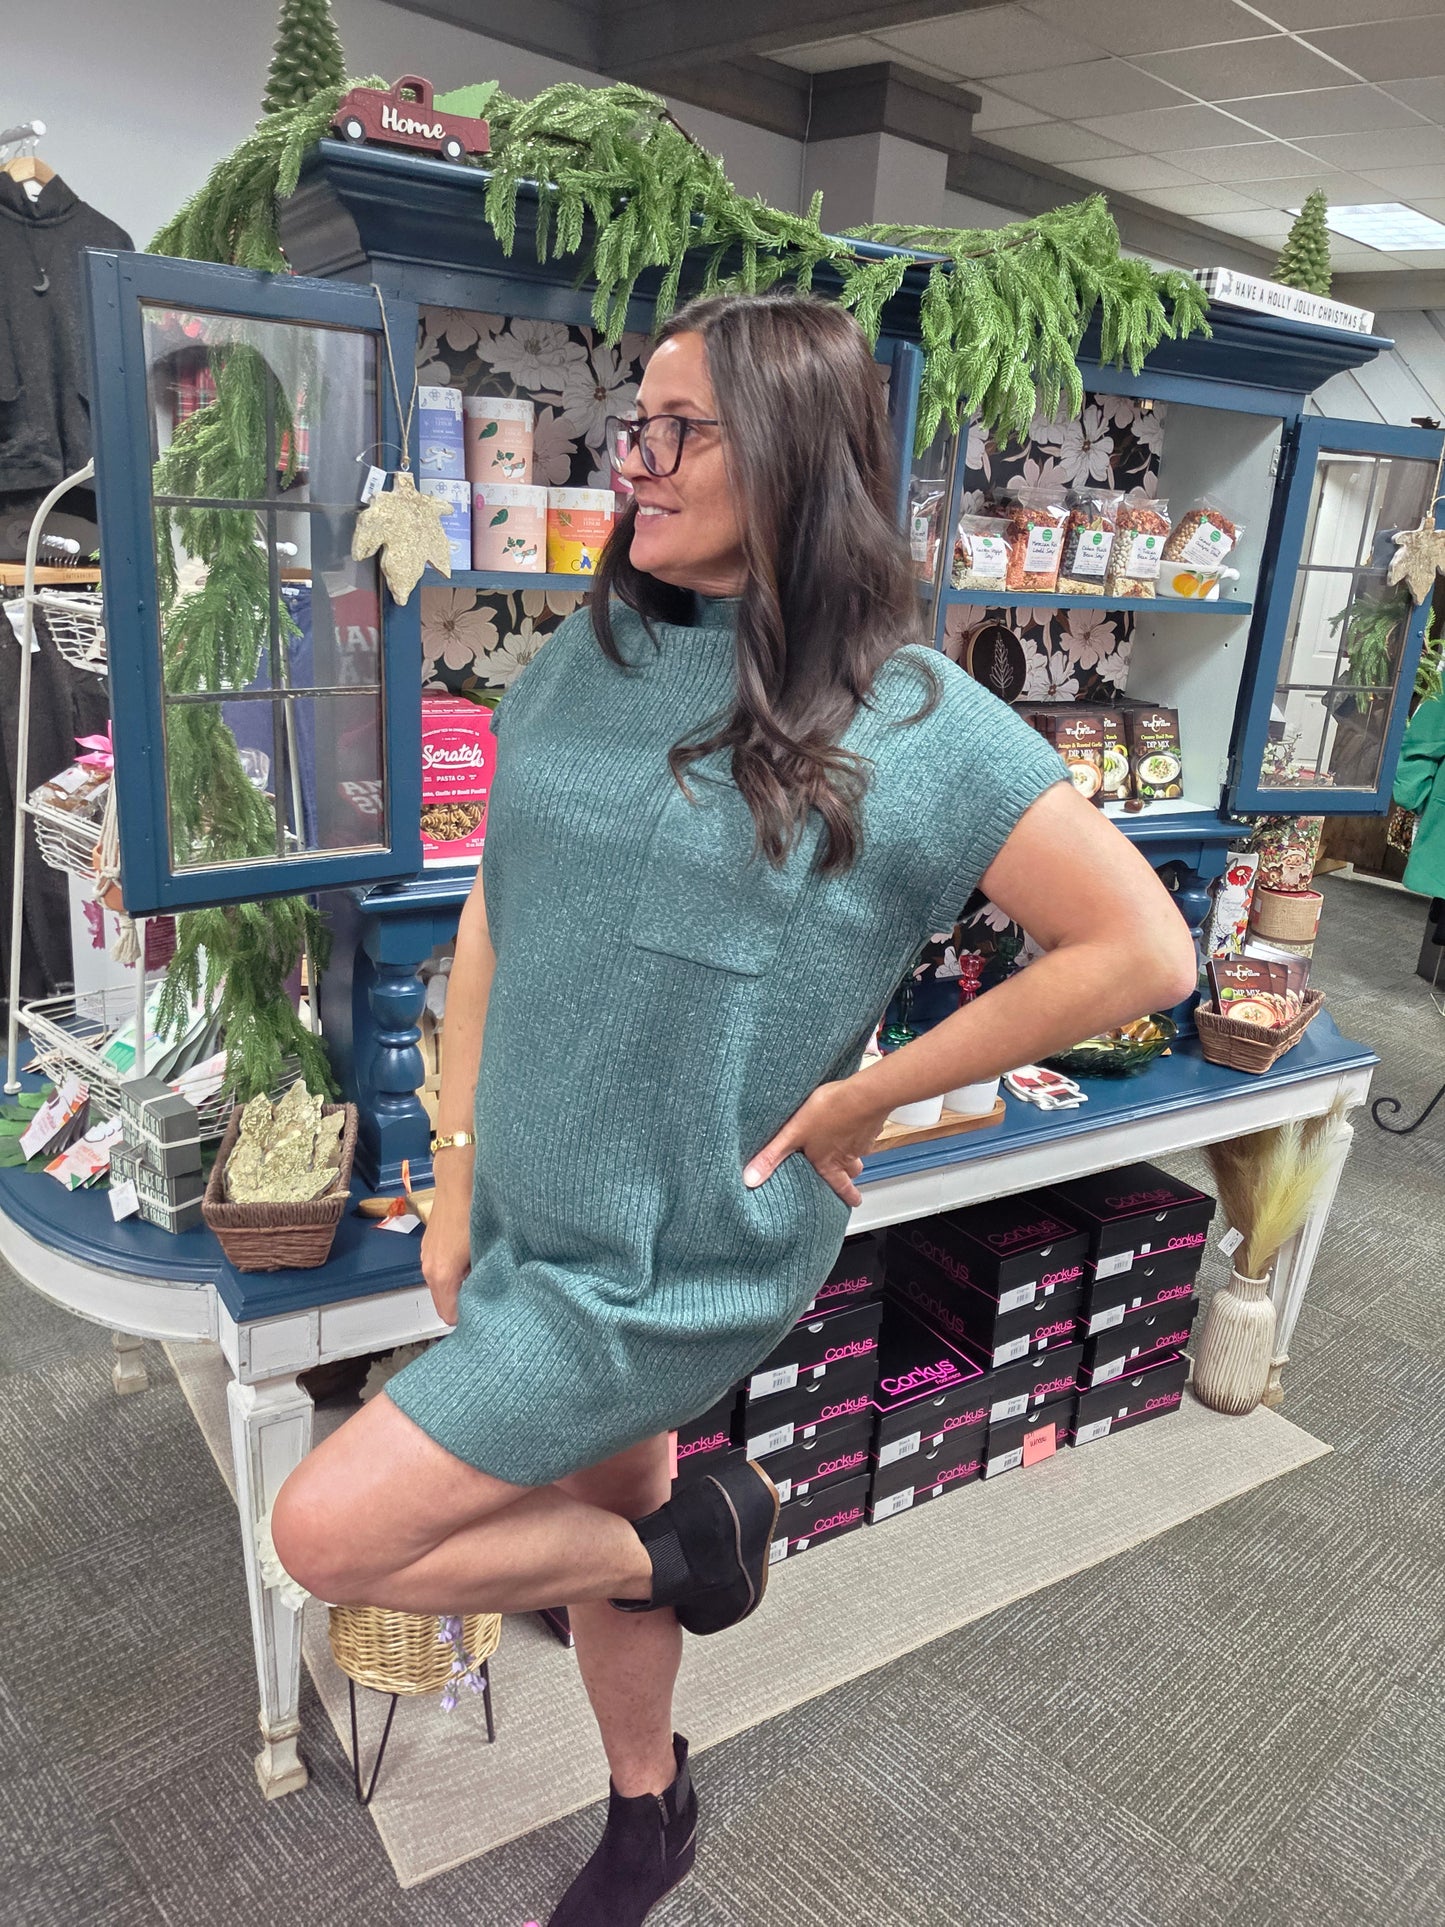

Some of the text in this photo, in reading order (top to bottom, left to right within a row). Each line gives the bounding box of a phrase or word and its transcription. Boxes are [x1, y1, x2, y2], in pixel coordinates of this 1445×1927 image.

[382, 104, 446, 139] Home
[1235, 281, 1358, 329] HAVE A HOLLY JOLLY CHRISTMAS
[1068, 749, 1093, 757] DIP MIX
[1157, 740, 1169, 748] MIX
[422, 743, 484, 769] Scratch
[1245, 988, 1261, 996] MIX
[988, 1219, 1057, 1246] Corkys
[1168, 1232, 1204, 1249] Corkys
[911, 1230, 969, 1280] Corkys
[819, 1276, 868, 1297] Corkys
[1042, 1266, 1080, 1285] Corkys
[1157, 1283, 1192, 1301] Corkys
[909, 1281, 965, 1333] Corkys
[1035, 1319, 1073, 1339] Corkys
[1155, 1329, 1189, 1348] Corkys
[825, 1338, 874, 1362] Corkys
[881, 1360, 956, 1392] Corkys
[1034, 1375, 1073, 1394] Corkys
[821, 1395, 868, 1418] Corkys
[1146, 1391, 1180, 1409] Corkys
[944, 1407, 984, 1430] Corkys
[677, 1432, 725, 1457] Corkys
[818, 1451, 864, 1475] Corkys
[937, 1459, 977, 1482] Corkys
[814, 1507, 860, 1532] Corkys
